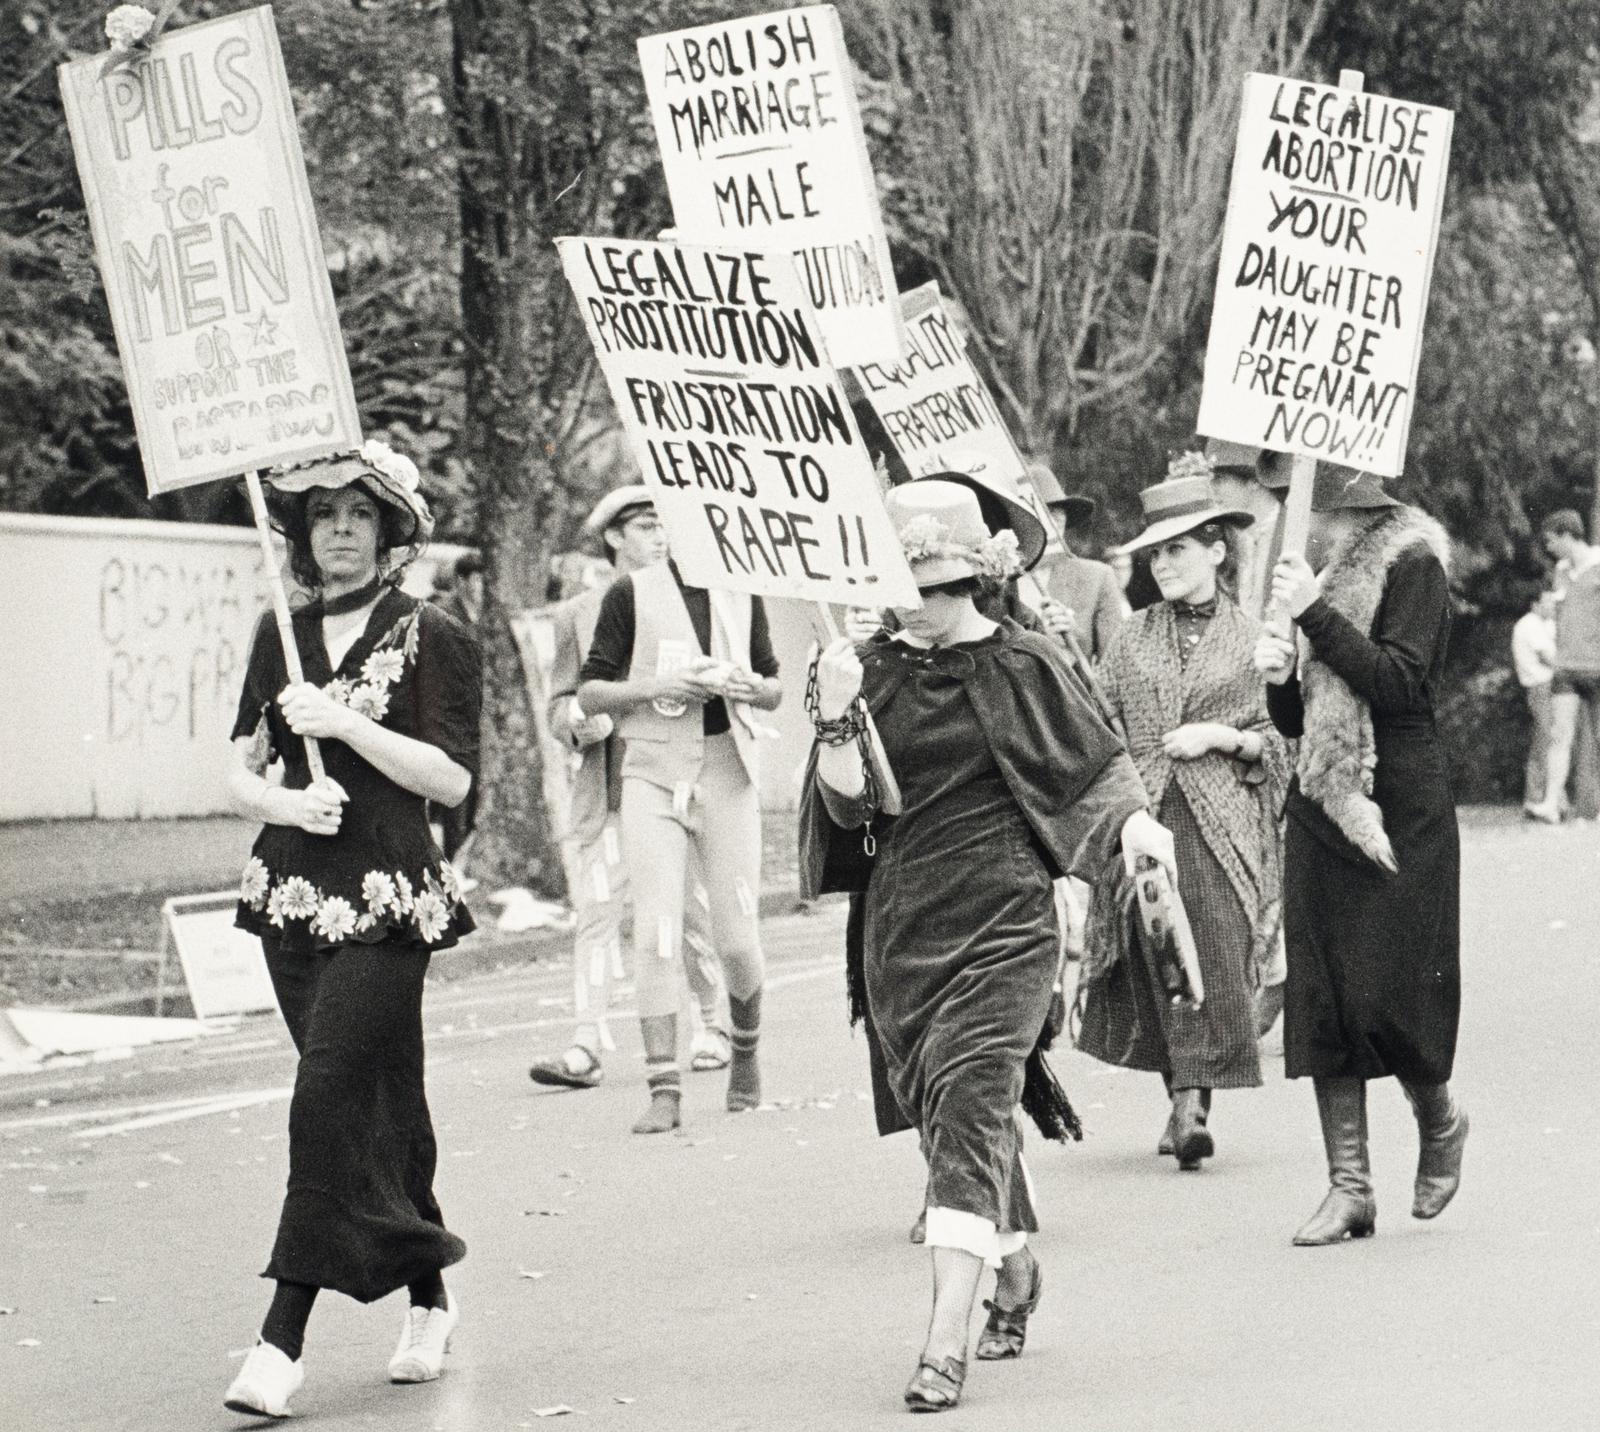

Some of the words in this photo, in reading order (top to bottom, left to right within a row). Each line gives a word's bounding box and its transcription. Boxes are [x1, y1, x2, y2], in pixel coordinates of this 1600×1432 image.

[664, 14, 816, 88] ABOLISH
[102, 36, 263, 160] PILLS
[668, 71, 837, 160] MARRIAGE
[1269, 83, 1432, 156] LEGALISE
[152, 163, 229, 229] for
[712, 162, 820, 228] MALE
[1262, 129, 1422, 211] ABORTION
[1267, 190, 1366, 255] YOUR
[121, 207, 289, 343] MEN
[584, 242, 777, 307] LEGALIZE
[1235, 243, 1402, 329] DAUGHTER
[194, 325, 240, 370] OR
[587, 296, 819, 371] PROSTITUTION
[1249, 306, 1318, 353] MAY
[1332, 322, 1381, 375] BE
[154, 366, 240, 410] SUPPORT
[246, 348, 299, 387] THE
[625, 377, 852, 446] FRUSTRATION
[1233, 350, 1407, 428] PREGNANT
[1264, 402, 1386, 461] NOW!!
[648, 439, 757, 498] LEADS
[764, 450, 829, 503] TO
